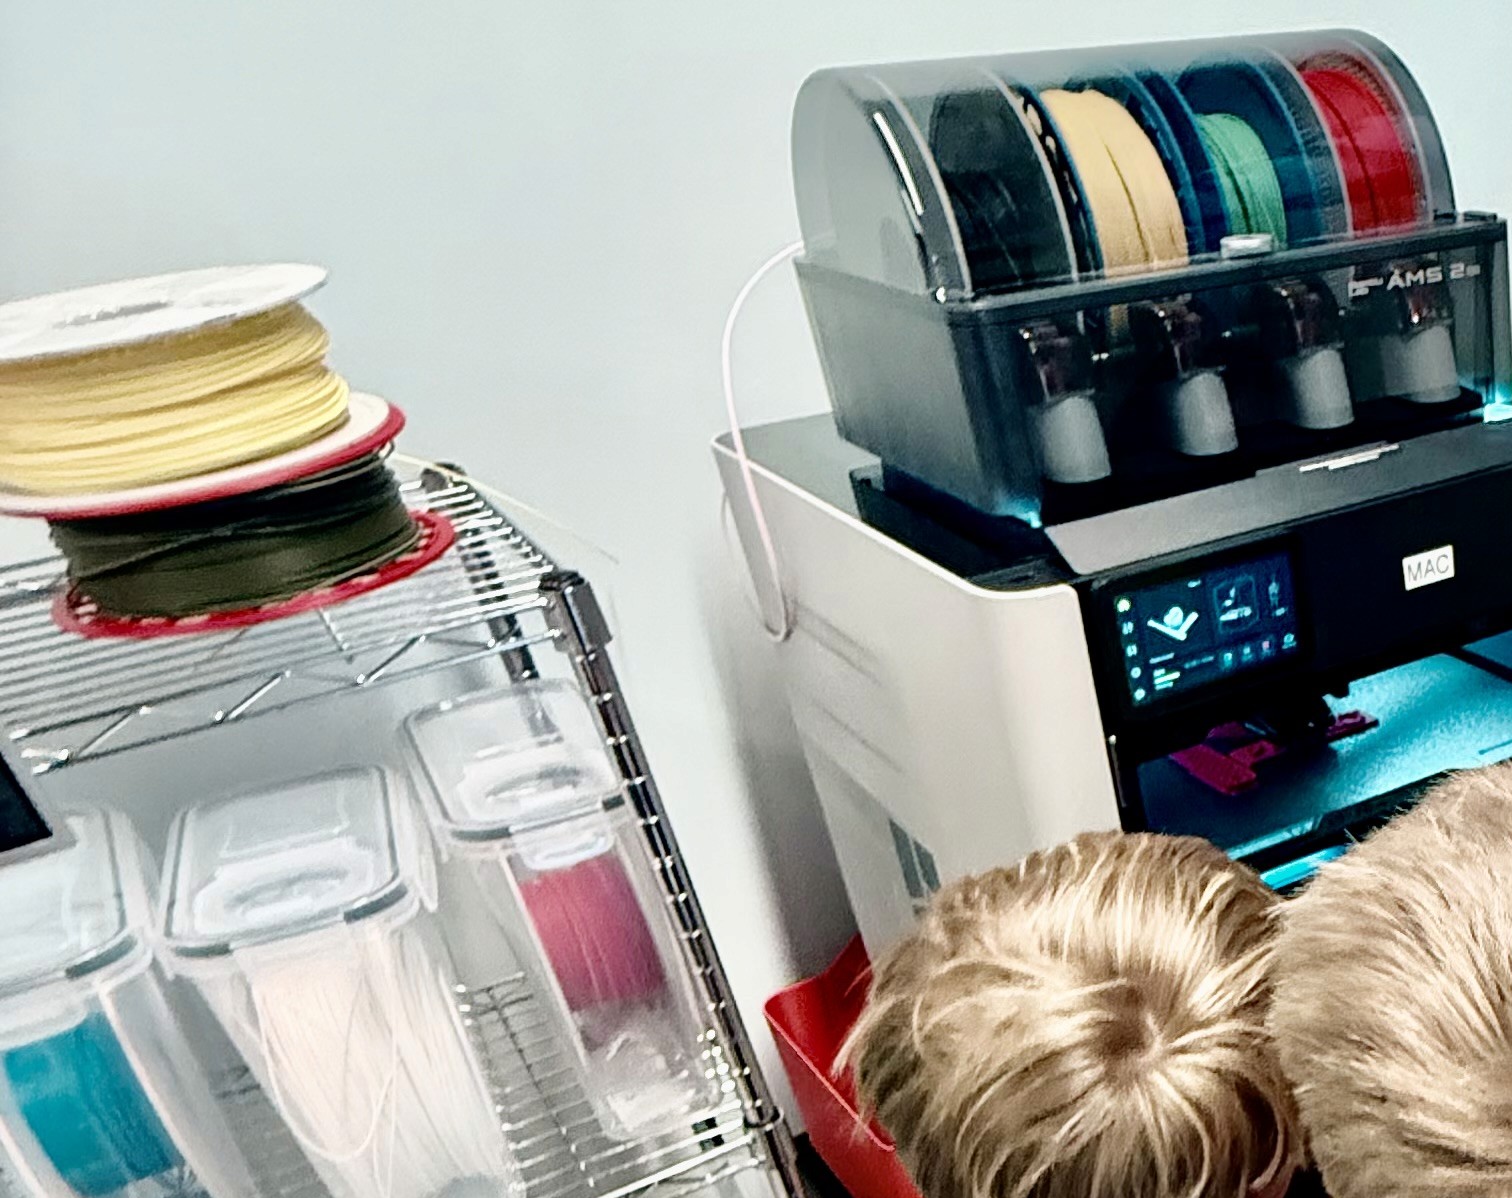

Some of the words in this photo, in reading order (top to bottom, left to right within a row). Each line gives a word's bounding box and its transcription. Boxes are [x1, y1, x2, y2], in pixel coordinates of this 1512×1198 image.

[1386, 266, 1443, 290] AMS
[1450, 262, 1465, 279] 2
[1407, 554, 1449, 582] MAC
